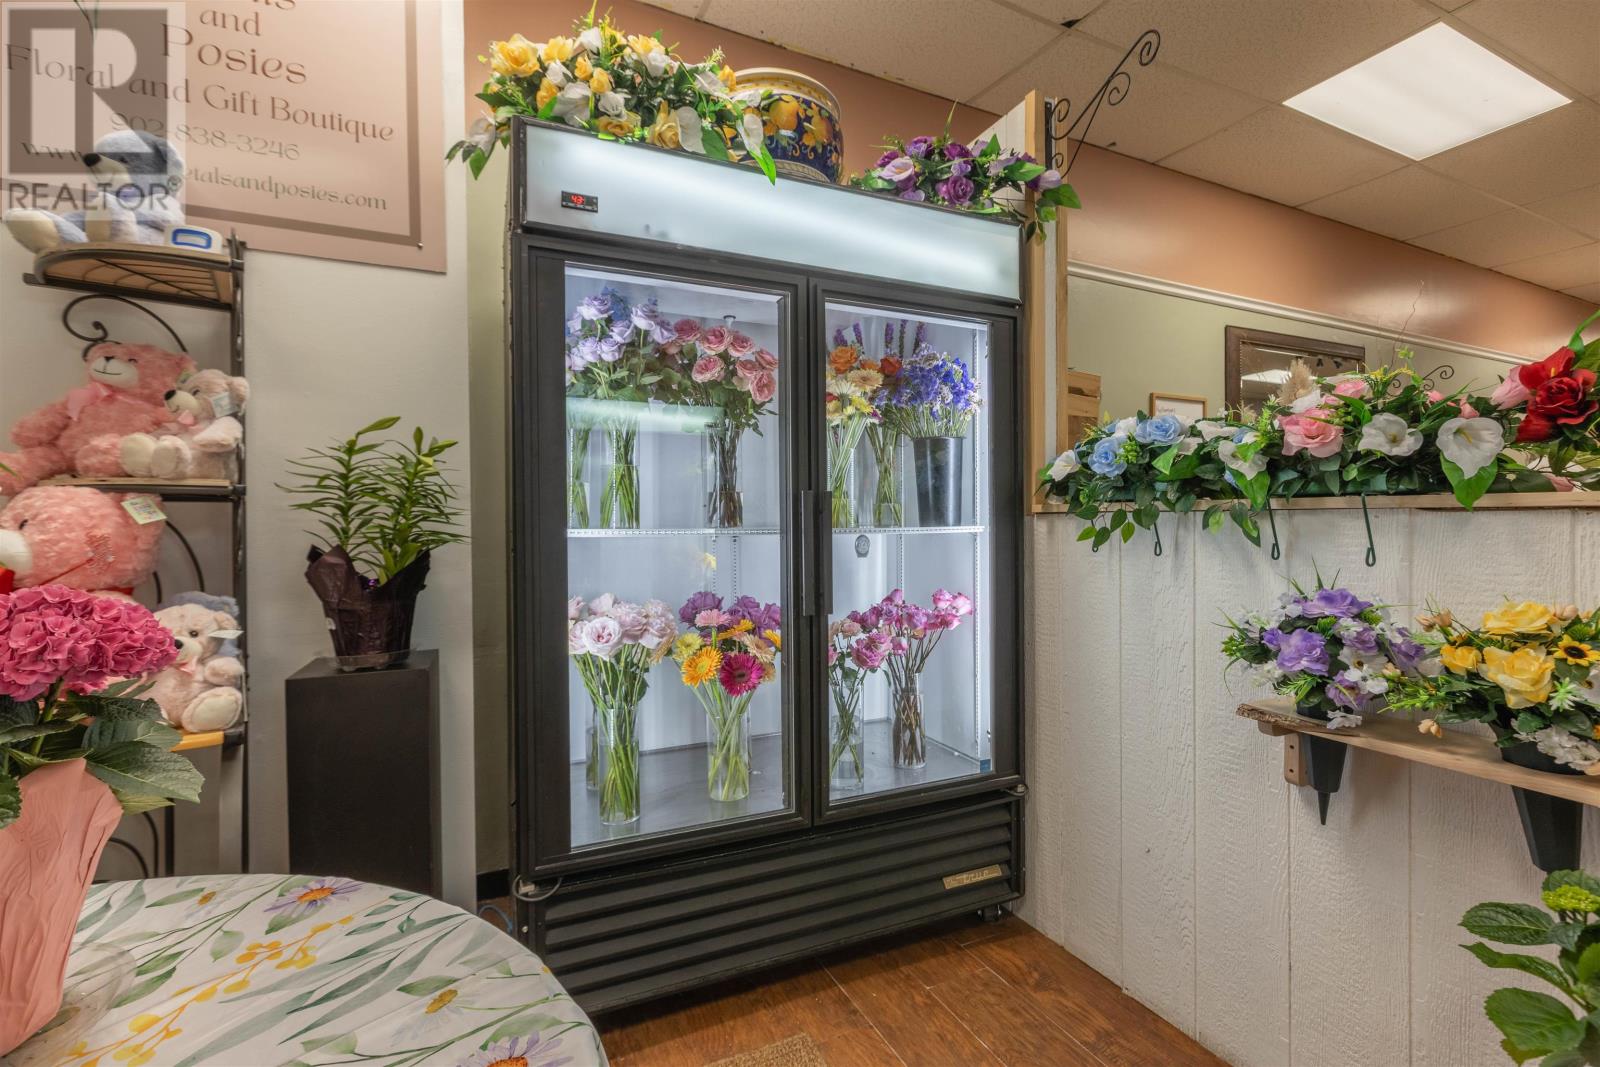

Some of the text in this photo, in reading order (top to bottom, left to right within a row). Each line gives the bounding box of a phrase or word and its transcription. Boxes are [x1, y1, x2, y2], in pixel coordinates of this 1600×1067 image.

[161, 22, 307, 85] Posies
[199, 9, 261, 37] and
[6, 43, 395, 144] Floral and Gift Boutique
